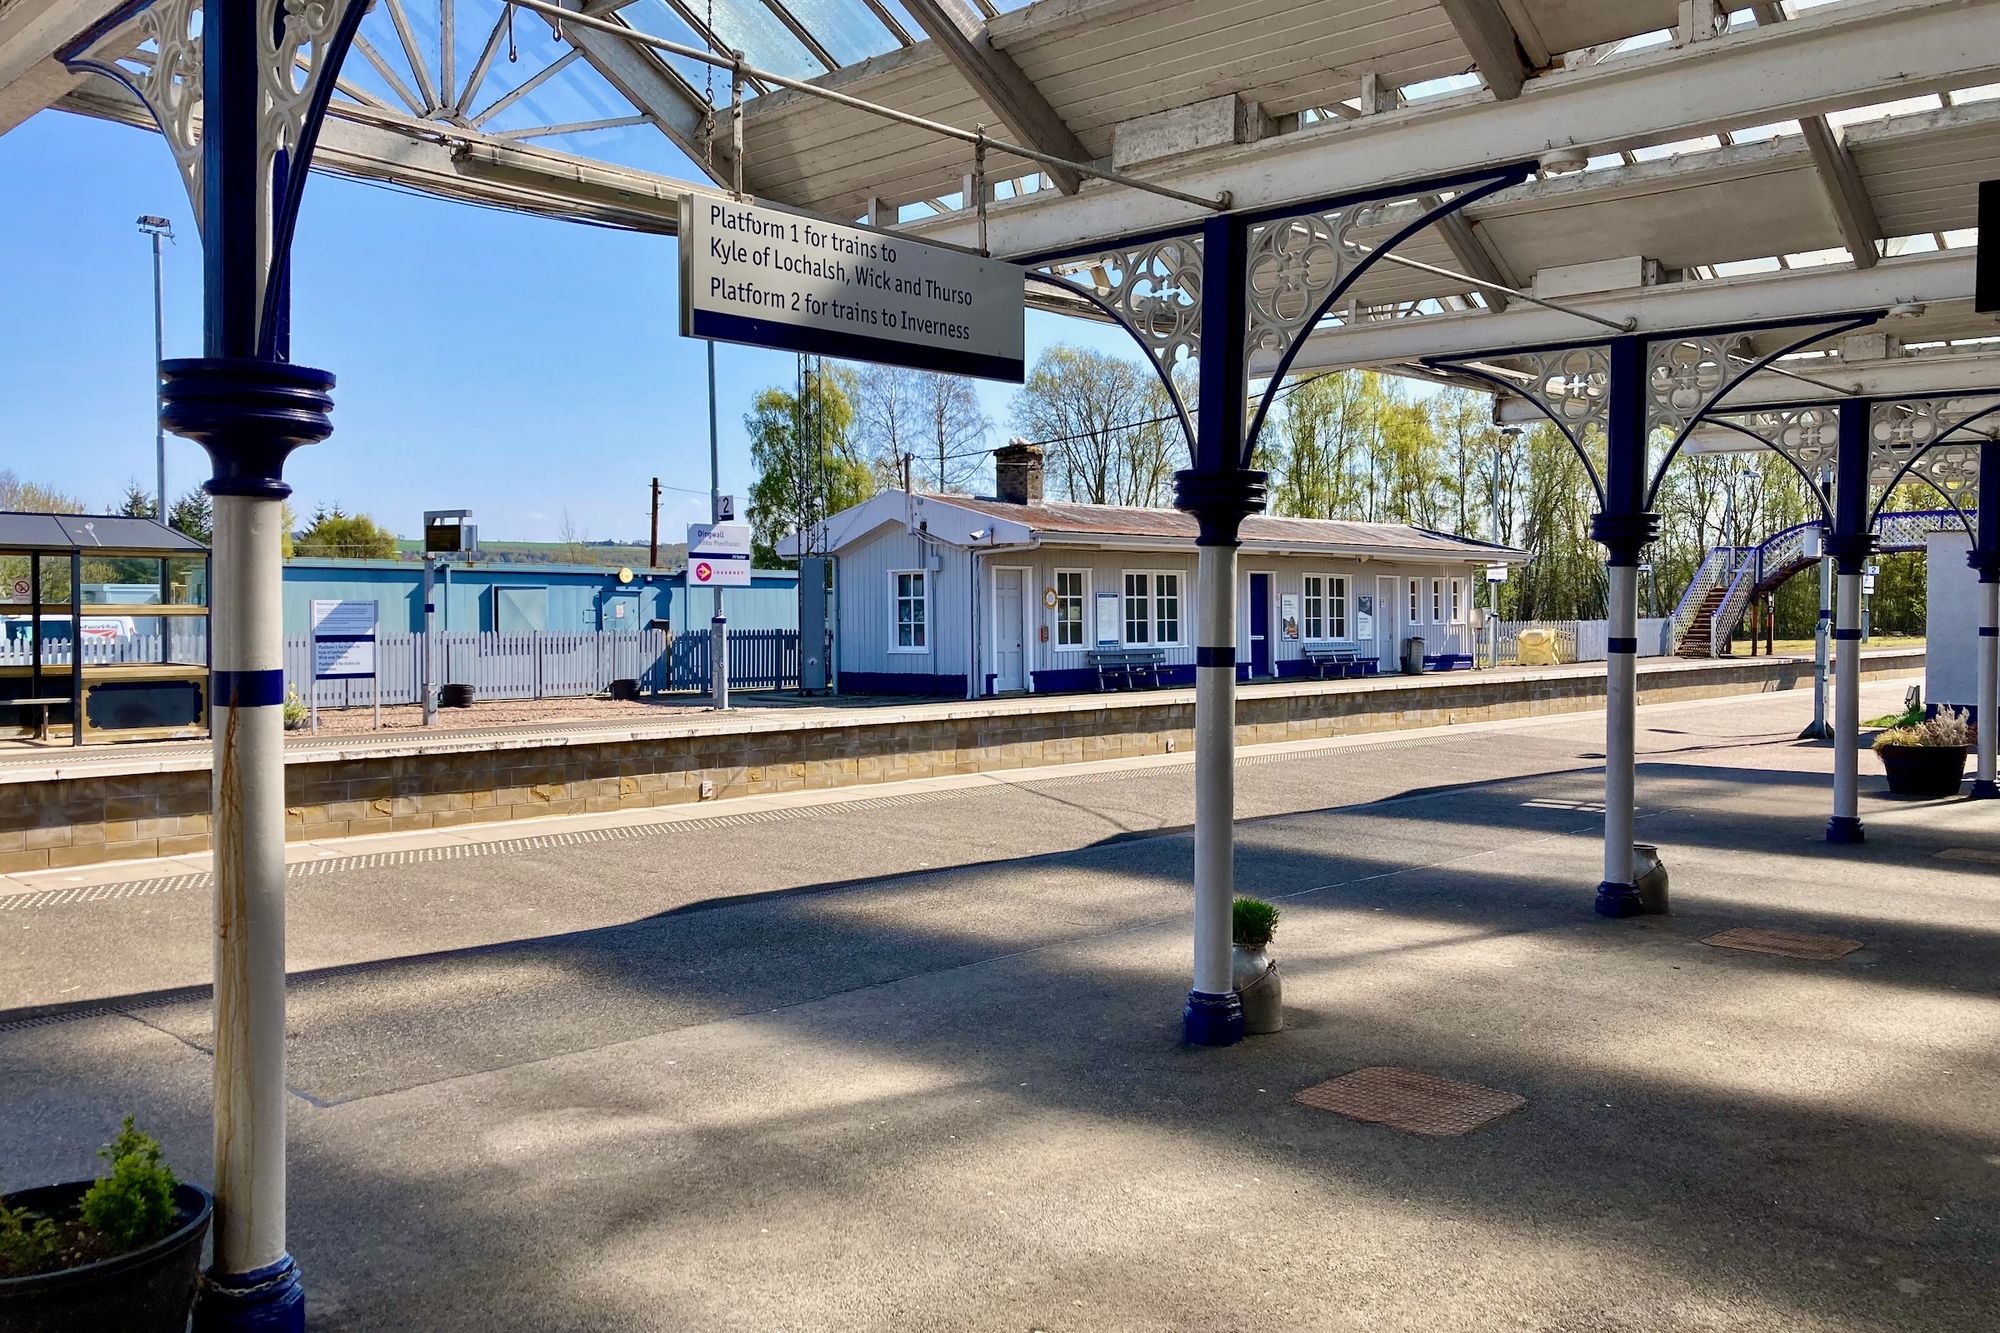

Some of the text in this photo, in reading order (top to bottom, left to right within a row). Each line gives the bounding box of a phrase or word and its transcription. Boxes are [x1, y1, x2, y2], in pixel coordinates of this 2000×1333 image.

[711, 205, 897, 263] Platform 1 for trains to
[711, 236, 972, 306] Kyle of Lochalsh, Wick and Thurso
[711, 276, 970, 340] Platform 2 for trains to Inverness
[723, 497, 729, 513] 2
[697, 530, 725, 539] Dingwall
